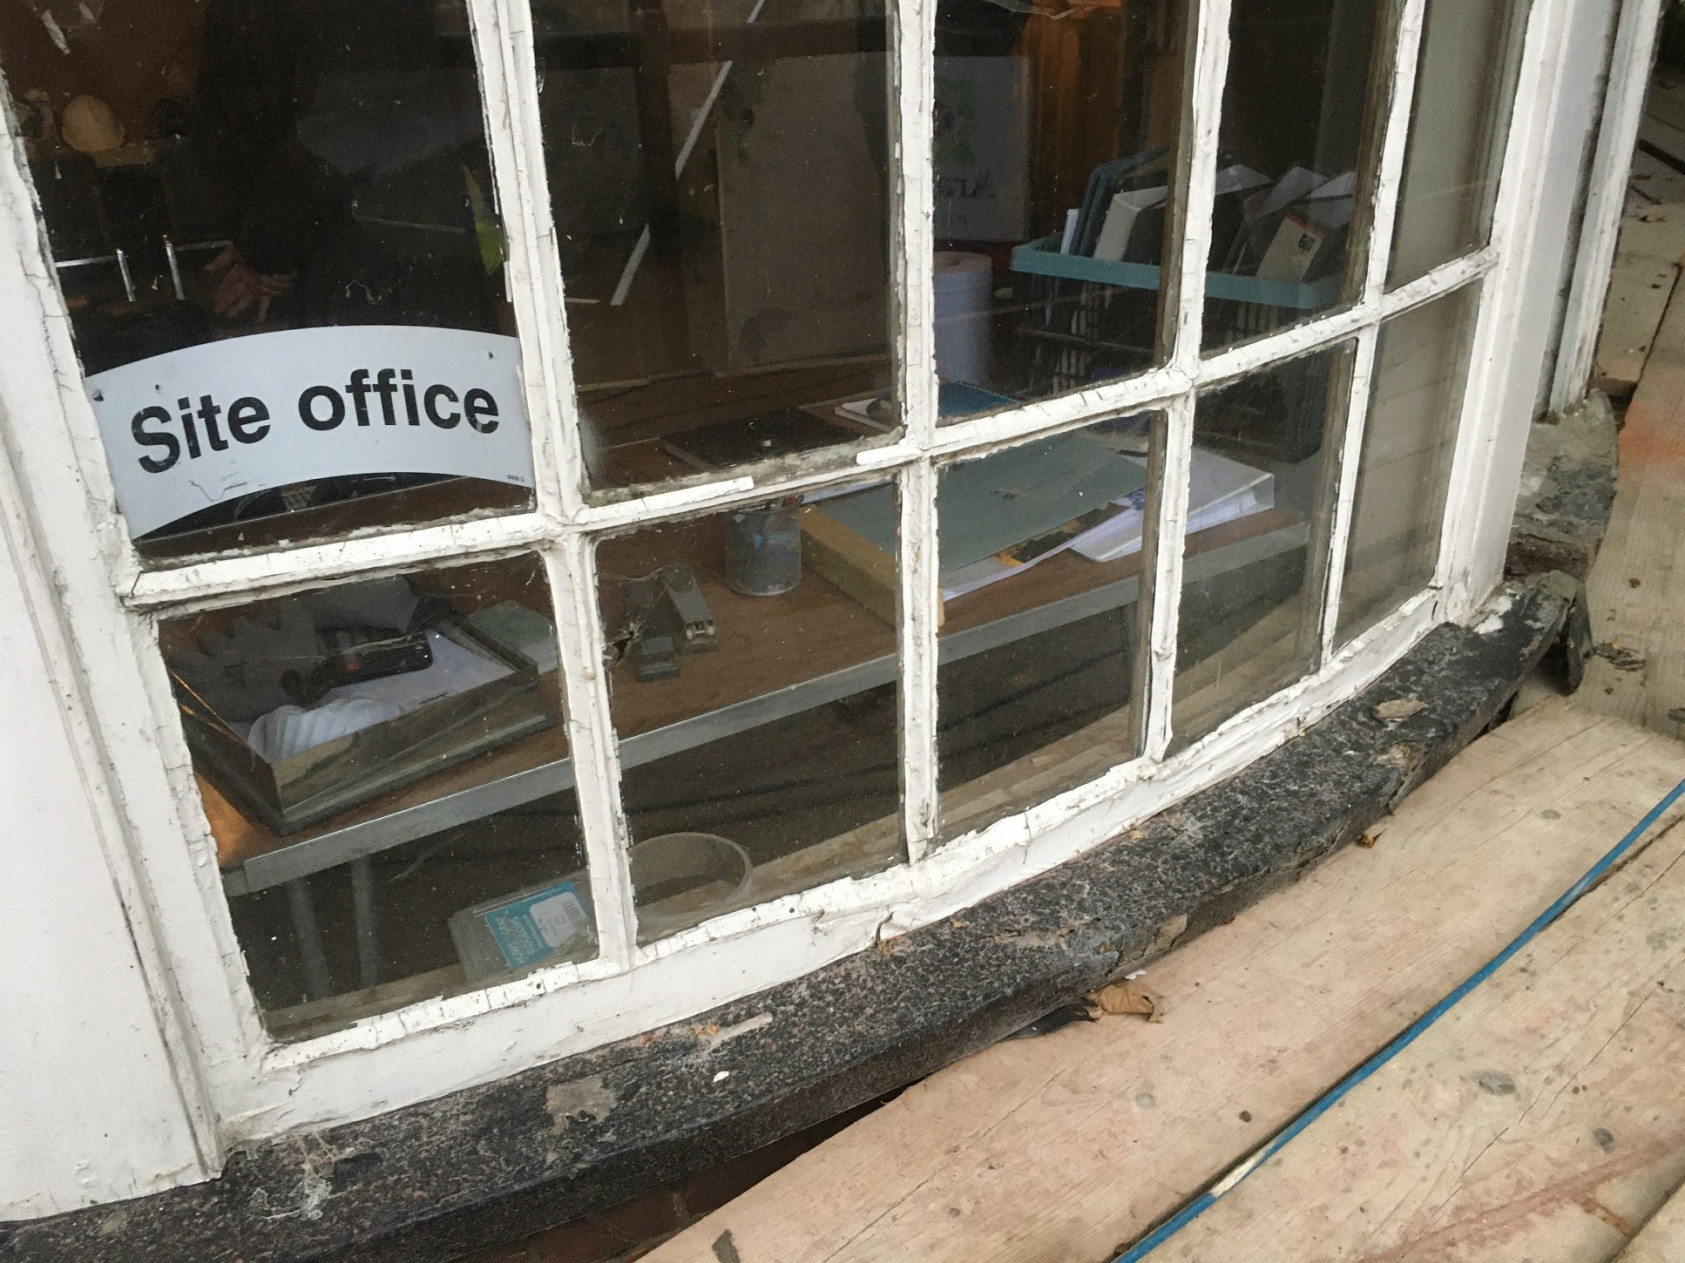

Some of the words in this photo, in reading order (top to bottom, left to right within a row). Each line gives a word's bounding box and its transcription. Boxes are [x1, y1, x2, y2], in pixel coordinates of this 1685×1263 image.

[130, 394, 271, 474] Site
[298, 368, 499, 434] office
[511, 916, 537, 955] RIDGEONS
